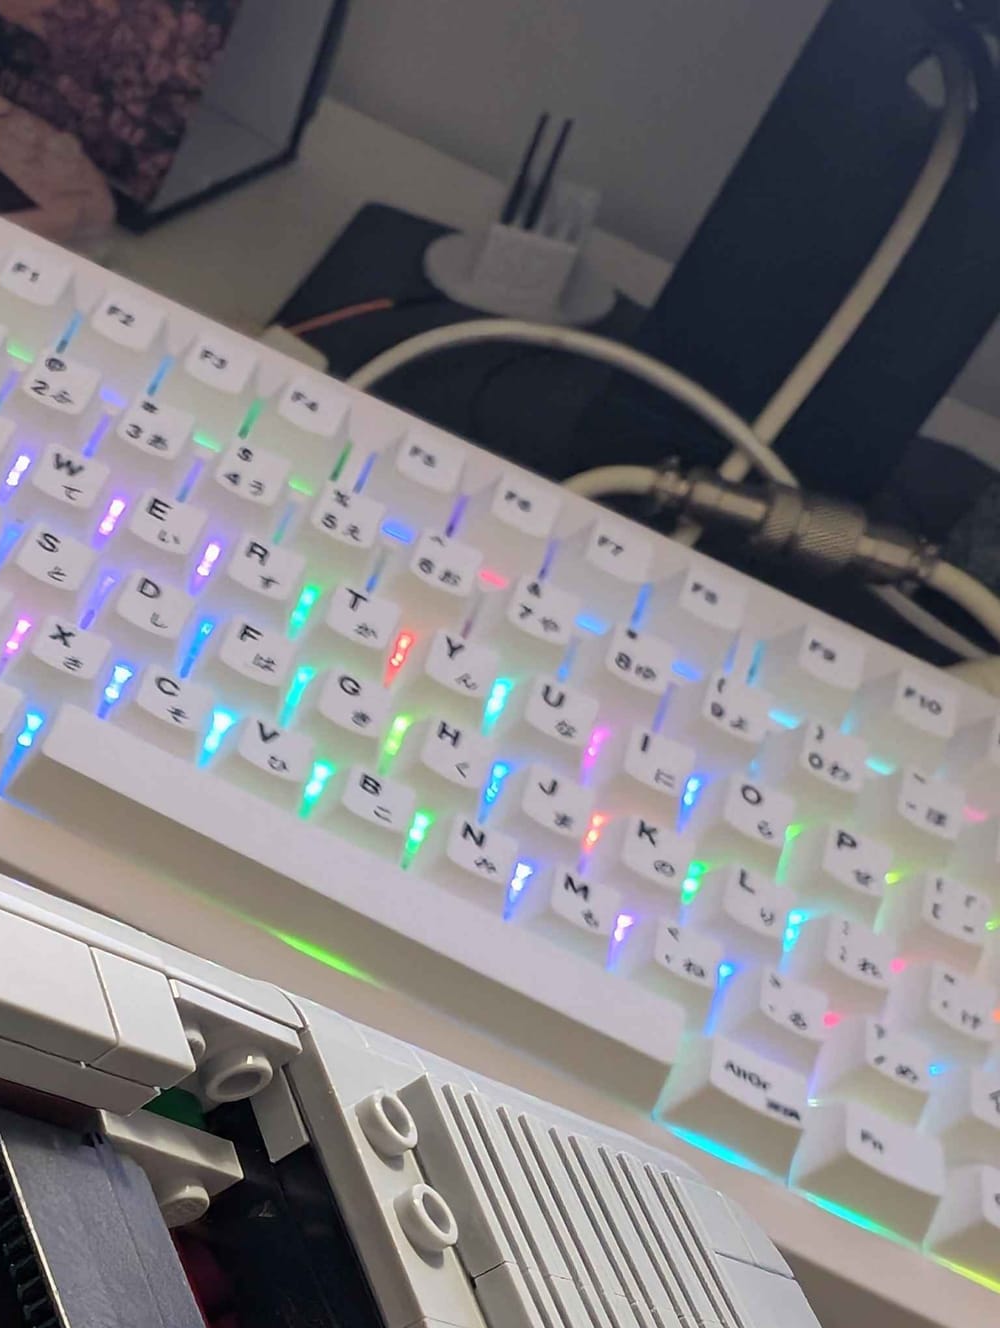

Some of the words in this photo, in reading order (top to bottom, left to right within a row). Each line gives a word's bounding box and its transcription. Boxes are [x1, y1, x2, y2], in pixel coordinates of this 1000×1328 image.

[11, 261, 40, 282] F1
[106, 305, 136, 327] F2
[200, 349, 228, 370] F3
[31, 379, 50, 396] 2
[125, 423, 144, 439] 3
[52, 453, 85, 477] W
[224, 472, 241, 486] 4
[146, 497, 172, 522] E
[321, 513, 338, 530] 5
[36, 532, 62, 553] S
[245, 541, 271, 566] R
[418, 557, 436, 575] 6
[136, 578, 162, 599] D
[345, 587, 369, 612] T
[518, 603, 534, 619] 7
[49, 624, 76, 648] X
[238, 623, 263, 643] F
[445, 635, 465, 660] Y
[615, 651, 631, 670] 8
[155, 676, 181, 697] C
[338, 675, 362, 697] G
[541, 684, 566, 709] U
[710, 702, 725, 719] 9
[903, 685, 942, 716] F10
[257, 719, 280, 743] V
[436, 721, 462, 748] H
[640, 733, 650, 752] I
[808, 752, 824, 770] 0
[359, 773, 383, 796] B
[538, 779, 558, 797] J
[740, 784, 762, 806] O
[461, 822, 485, 848] N
[637, 819, 657, 847] K
[836, 829, 857, 850] P
[563, 873, 590, 901] M
[738, 868, 756, 895] L
[860, 1129, 884, 1154] Fn
